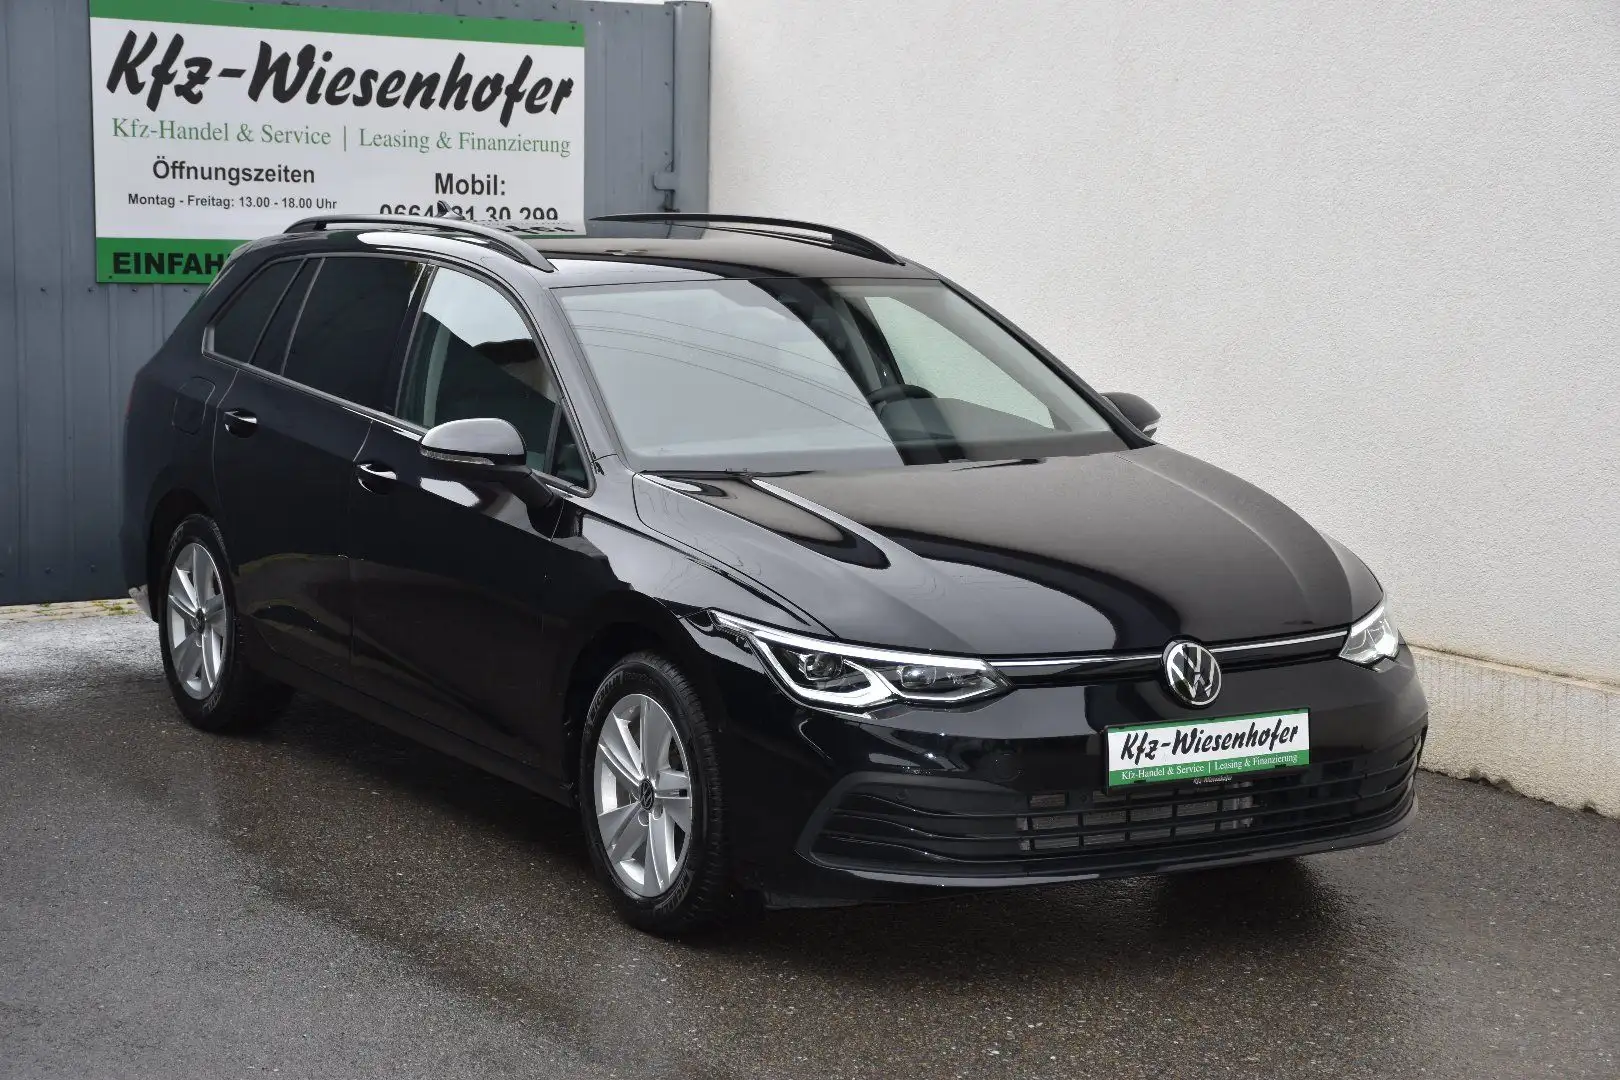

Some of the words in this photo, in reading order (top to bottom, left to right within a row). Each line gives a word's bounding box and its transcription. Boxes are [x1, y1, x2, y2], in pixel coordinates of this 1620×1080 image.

[106, 30, 574, 127] Kfz-Wiesenhofer
[112, 117, 229, 142] Kfz-Handel
[236, 123, 254, 142] &
[261, 124, 332, 145] Service
[359, 128, 430, 153] Leasing
[436, 131, 452, 149] &
[458, 132, 571, 157] Finanzierung
[153, 156, 316, 186] Öffnungszeiten
[435, 173, 506, 196] Mobil:
[128, 193, 175, 208] Montag
[187, 195, 235, 210] Freitag:
[239, 197, 270, 208] 13.00
[282, 199, 312, 209] 18.00
[316, 199, 338, 210] Uhr
[113, 252, 231, 275] EINFAH
[1120, 718, 1299, 766] Kfz-Wiesenhofer
[1121, 766, 1166, 780] Kfz-Handel
[1167, 765, 1174, 775] &
[1176, 763, 1205, 774] Service
[1214, 759, 1243, 771] Leasing
[1244, 757, 1252, 768] &
[1252, 753, 1298, 767] Finanzierung
